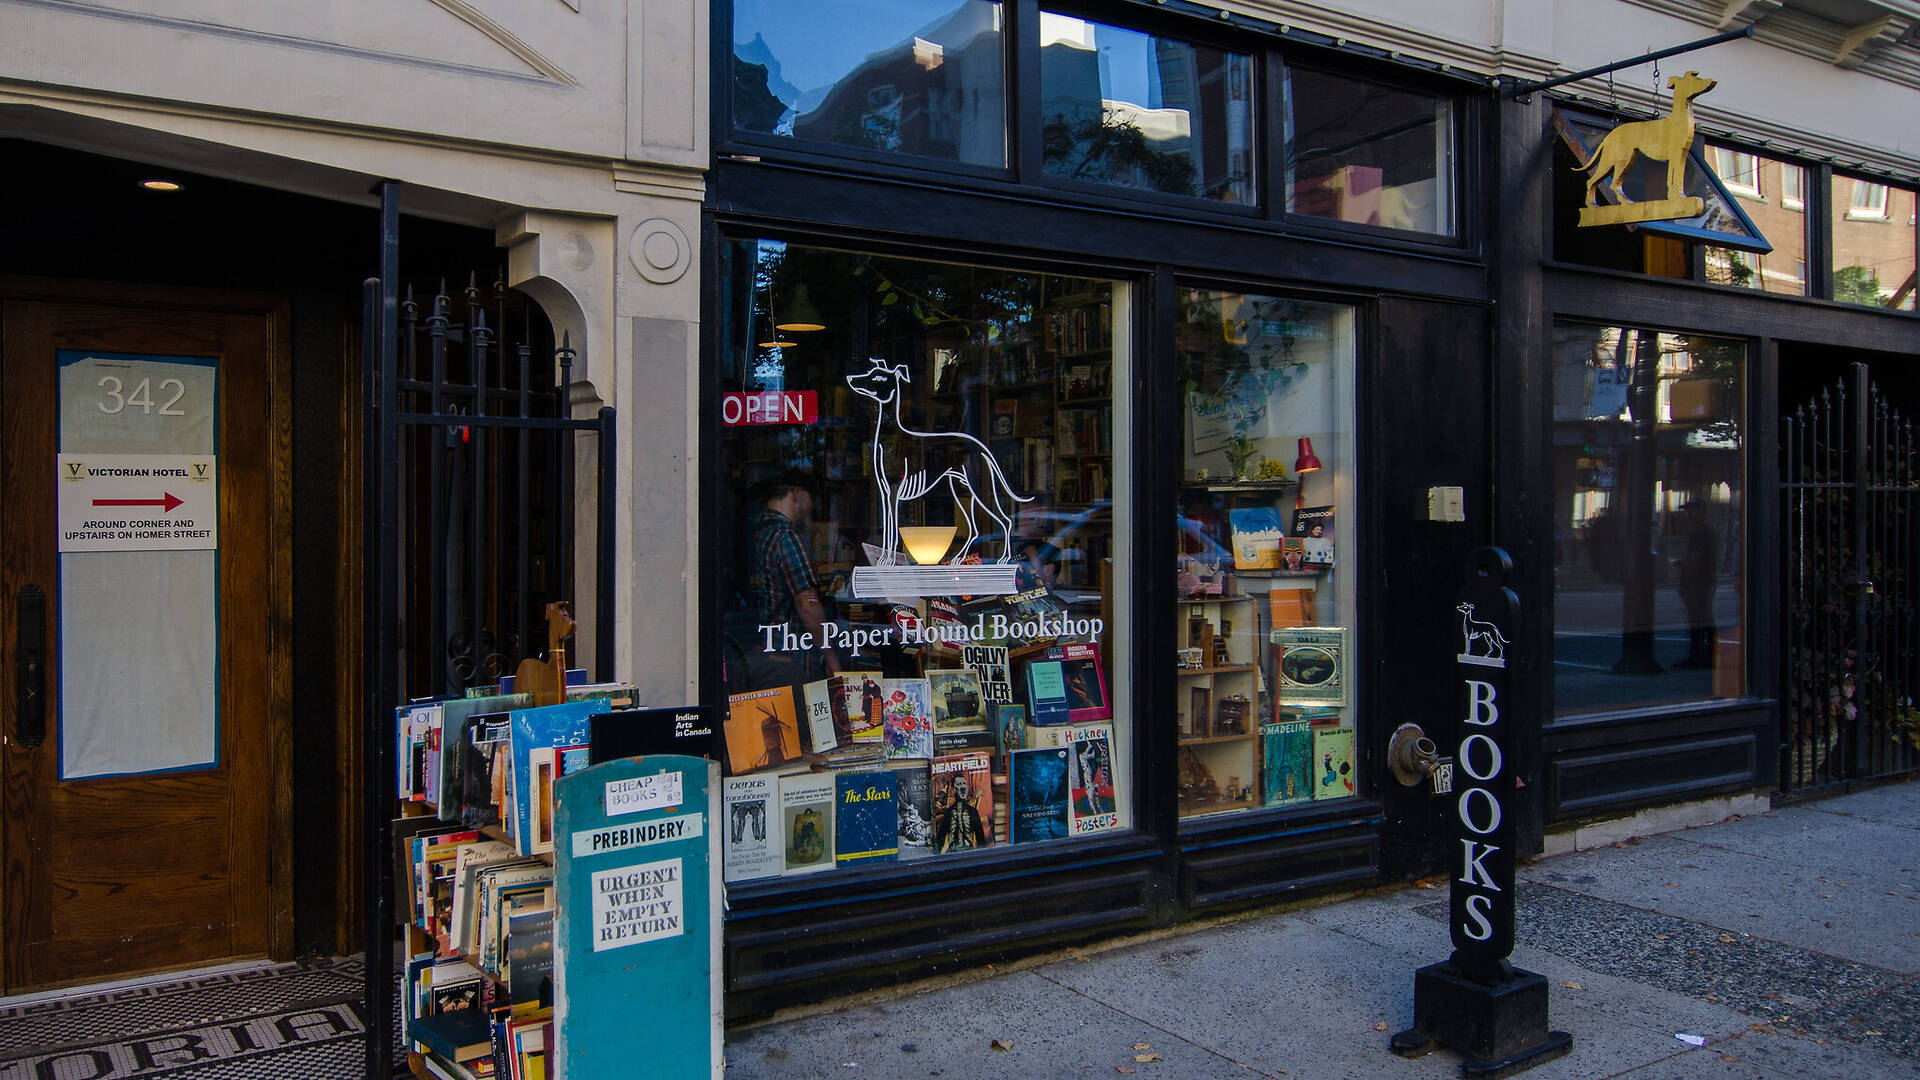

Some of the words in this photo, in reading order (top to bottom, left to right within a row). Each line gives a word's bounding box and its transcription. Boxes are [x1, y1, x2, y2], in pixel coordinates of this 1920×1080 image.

[97, 375, 186, 416] 342
[723, 395, 803, 424] OPEN
[88, 468, 150, 477] VICTORIAN
[153, 468, 189, 477] HOTEL
[83, 521, 127, 529] AROUND
[129, 520, 171, 528] CORNER
[173, 520, 194, 528] AND
[65, 531, 115, 540] UPSTAIRS
[135, 531, 171, 539] HOMER
[173, 530, 211, 538] STREET
[758, 622, 814, 653] The
[820, 622, 893, 657] Paper
[900, 613, 985, 645] Hound
[992, 610, 1104, 643] Bookshop
[964, 646, 1007, 665] OGILVY
[675, 713, 699, 721] Indian
[683, 727, 712, 737] Canada
[1065, 728, 1107, 743] Hockney
[1266, 722, 1311, 735] MADELINE
[932, 759, 988, 774] HEARTFIELD
[609, 776, 653, 793] CHEAP
[612, 788, 657, 806] BOOKS
[845, 789, 862, 804] The
[862, 786, 891, 801] Stars
[1458, 679, 1502, 941] BOOKS
[1075, 814, 1118, 832] Posters
[592, 820, 685, 850] PREBINDERY
[599, 866, 678, 893] URGENT
[608, 885, 664, 907] WHEN
[605, 900, 672, 924] EMPTY
[600, 915, 679, 941] RETURN
